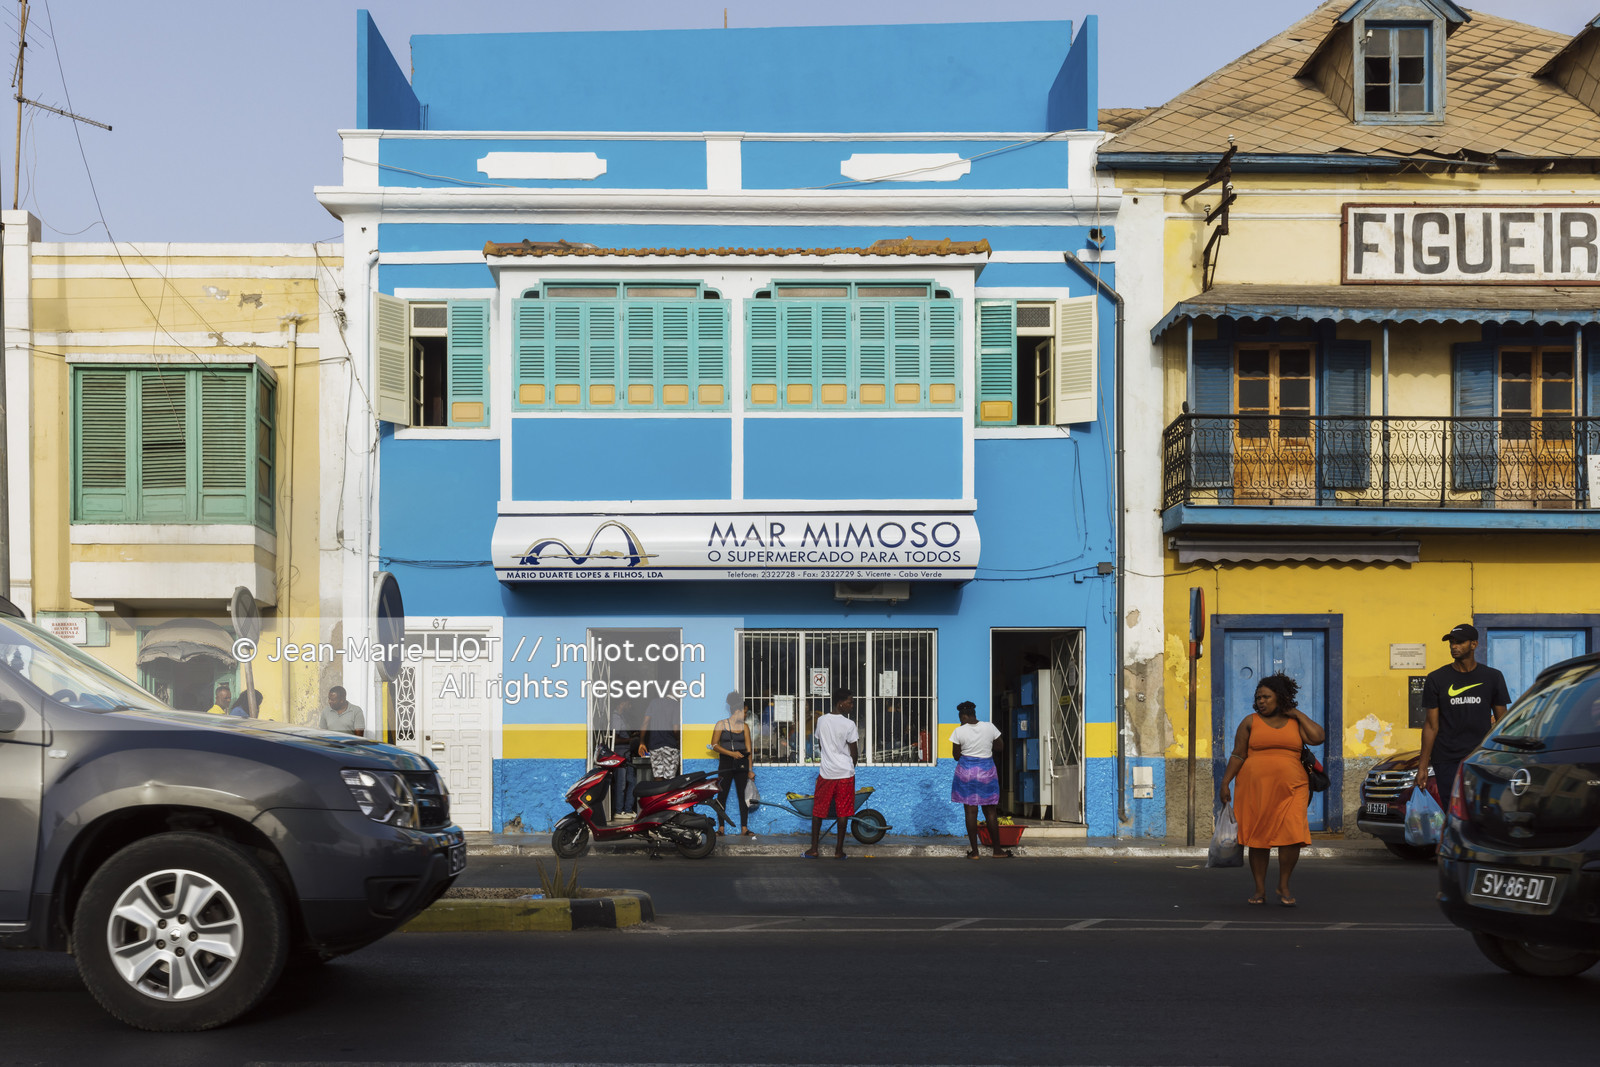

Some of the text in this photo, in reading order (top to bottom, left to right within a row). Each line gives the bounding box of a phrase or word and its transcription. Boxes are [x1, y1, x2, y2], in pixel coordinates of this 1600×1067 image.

[1353, 212, 1599, 274] FIGUEIR
[708, 521, 961, 548] MAR MIMOSO
[707, 550, 961, 563] O SUPERMERCADO PARA TODOS
[506, 570, 664, 579] MÁRIO DUARTE LOPES & FILHOS, LDA
[432, 617, 448, 630] 67
[1450, 696, 1481, 705] ORLANDO
[1481, 873, 1545, 900] SV-86-DI
